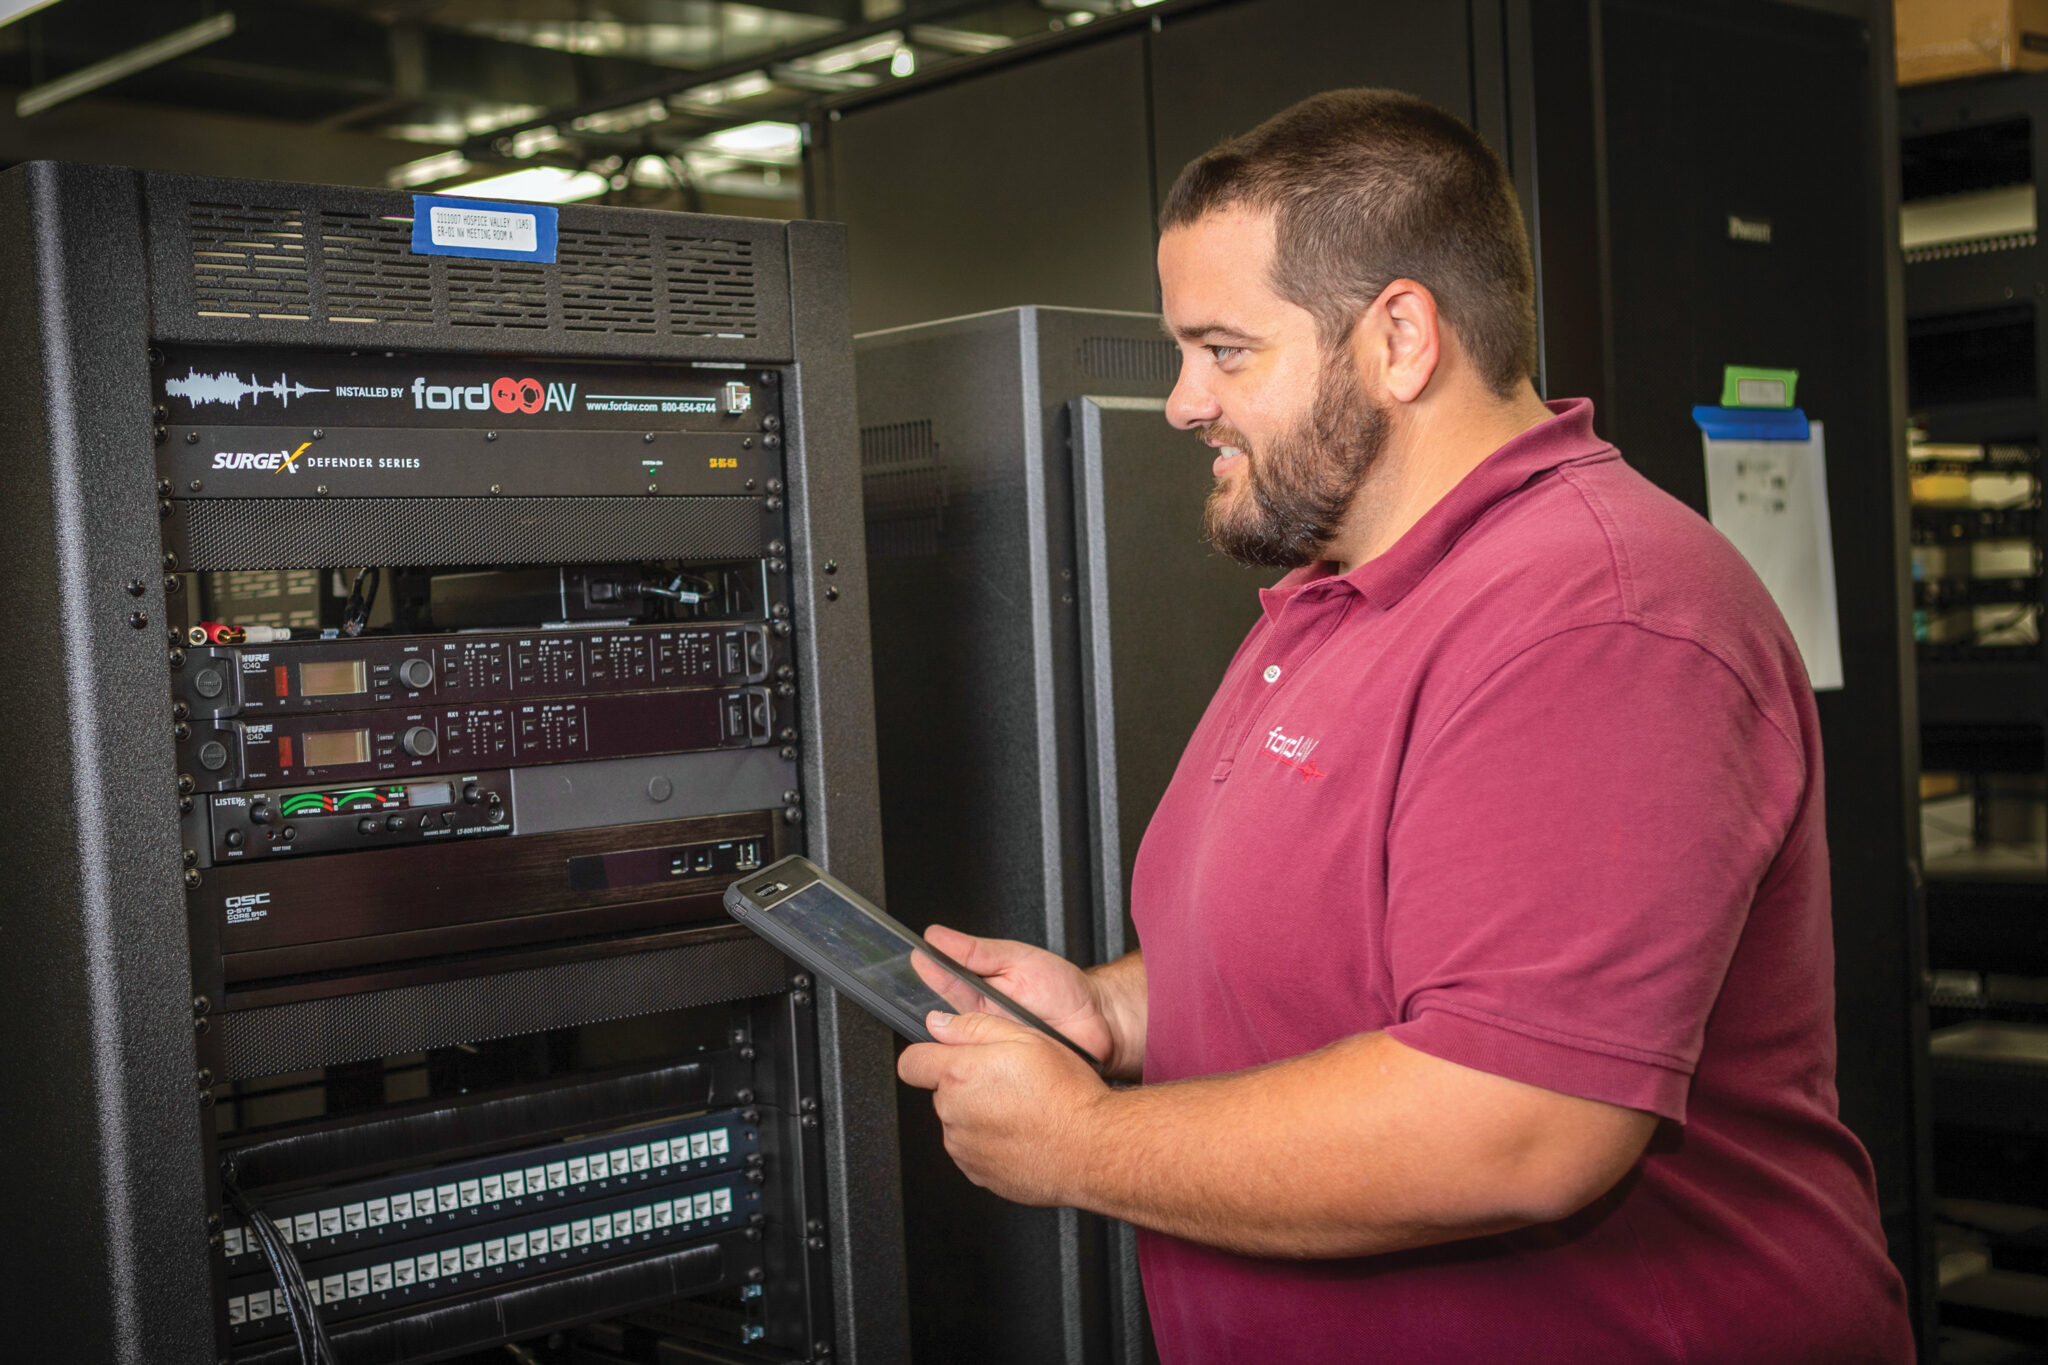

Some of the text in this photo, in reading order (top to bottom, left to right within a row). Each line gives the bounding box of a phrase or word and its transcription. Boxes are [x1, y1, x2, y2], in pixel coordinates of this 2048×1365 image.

[336, 377, 716, 413] INSTALLED BY ford AV www.fordav.com 800-654-6744
[212, 444, 420, 474] SURGEX DEFENDER SERIES
[242, 654, 270, 662] HURE
[246, 725, 272, 733] HURE
[226, 892, 270, 908] QSC
